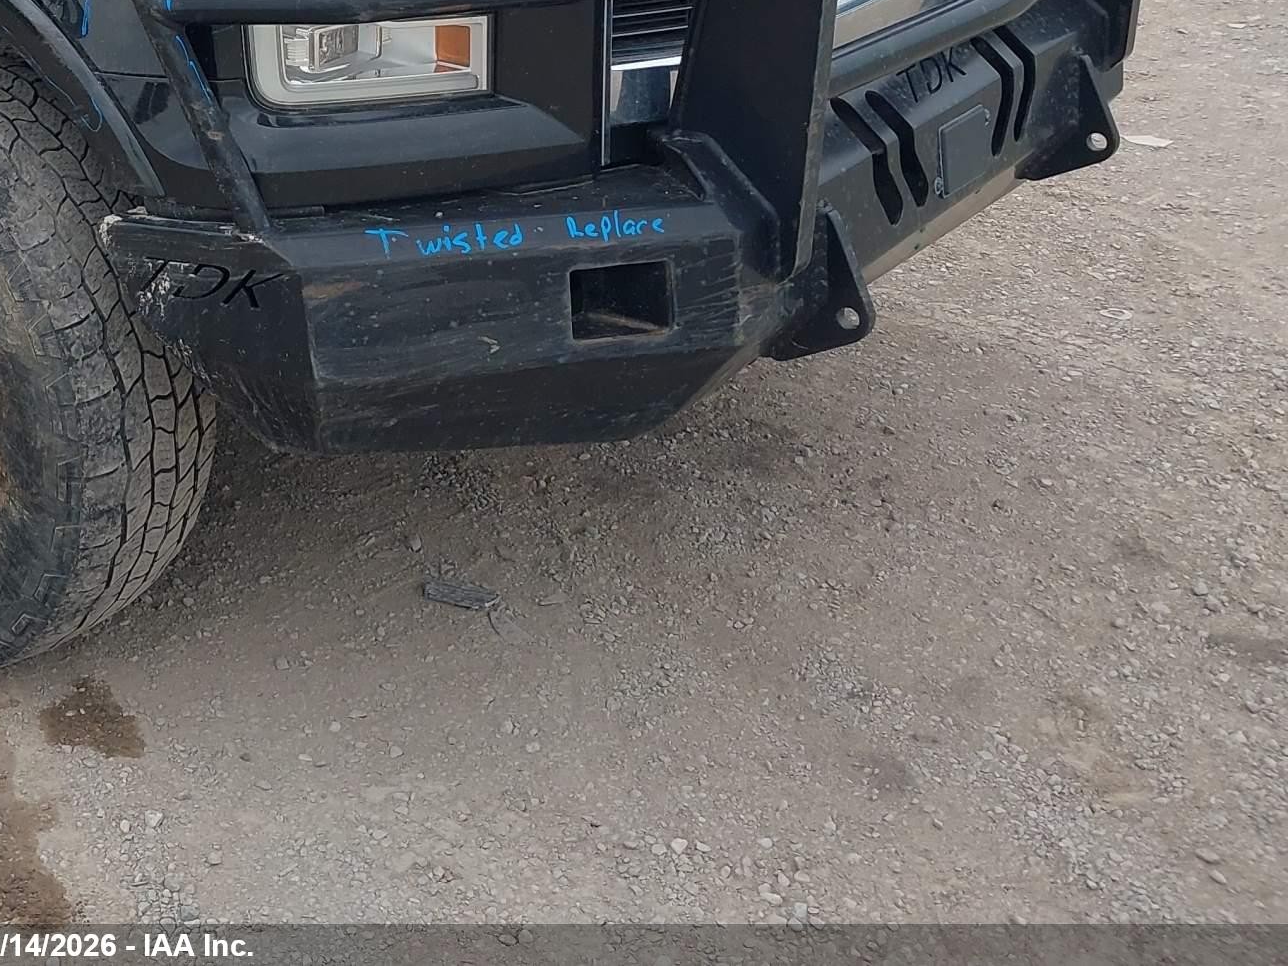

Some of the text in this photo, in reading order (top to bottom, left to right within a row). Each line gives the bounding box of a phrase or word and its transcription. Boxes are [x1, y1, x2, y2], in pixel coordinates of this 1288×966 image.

[895, 46, 967, 104] TDK
[565, 209, 665, 243] Replace
[137, 255, 285, 309] TDK
